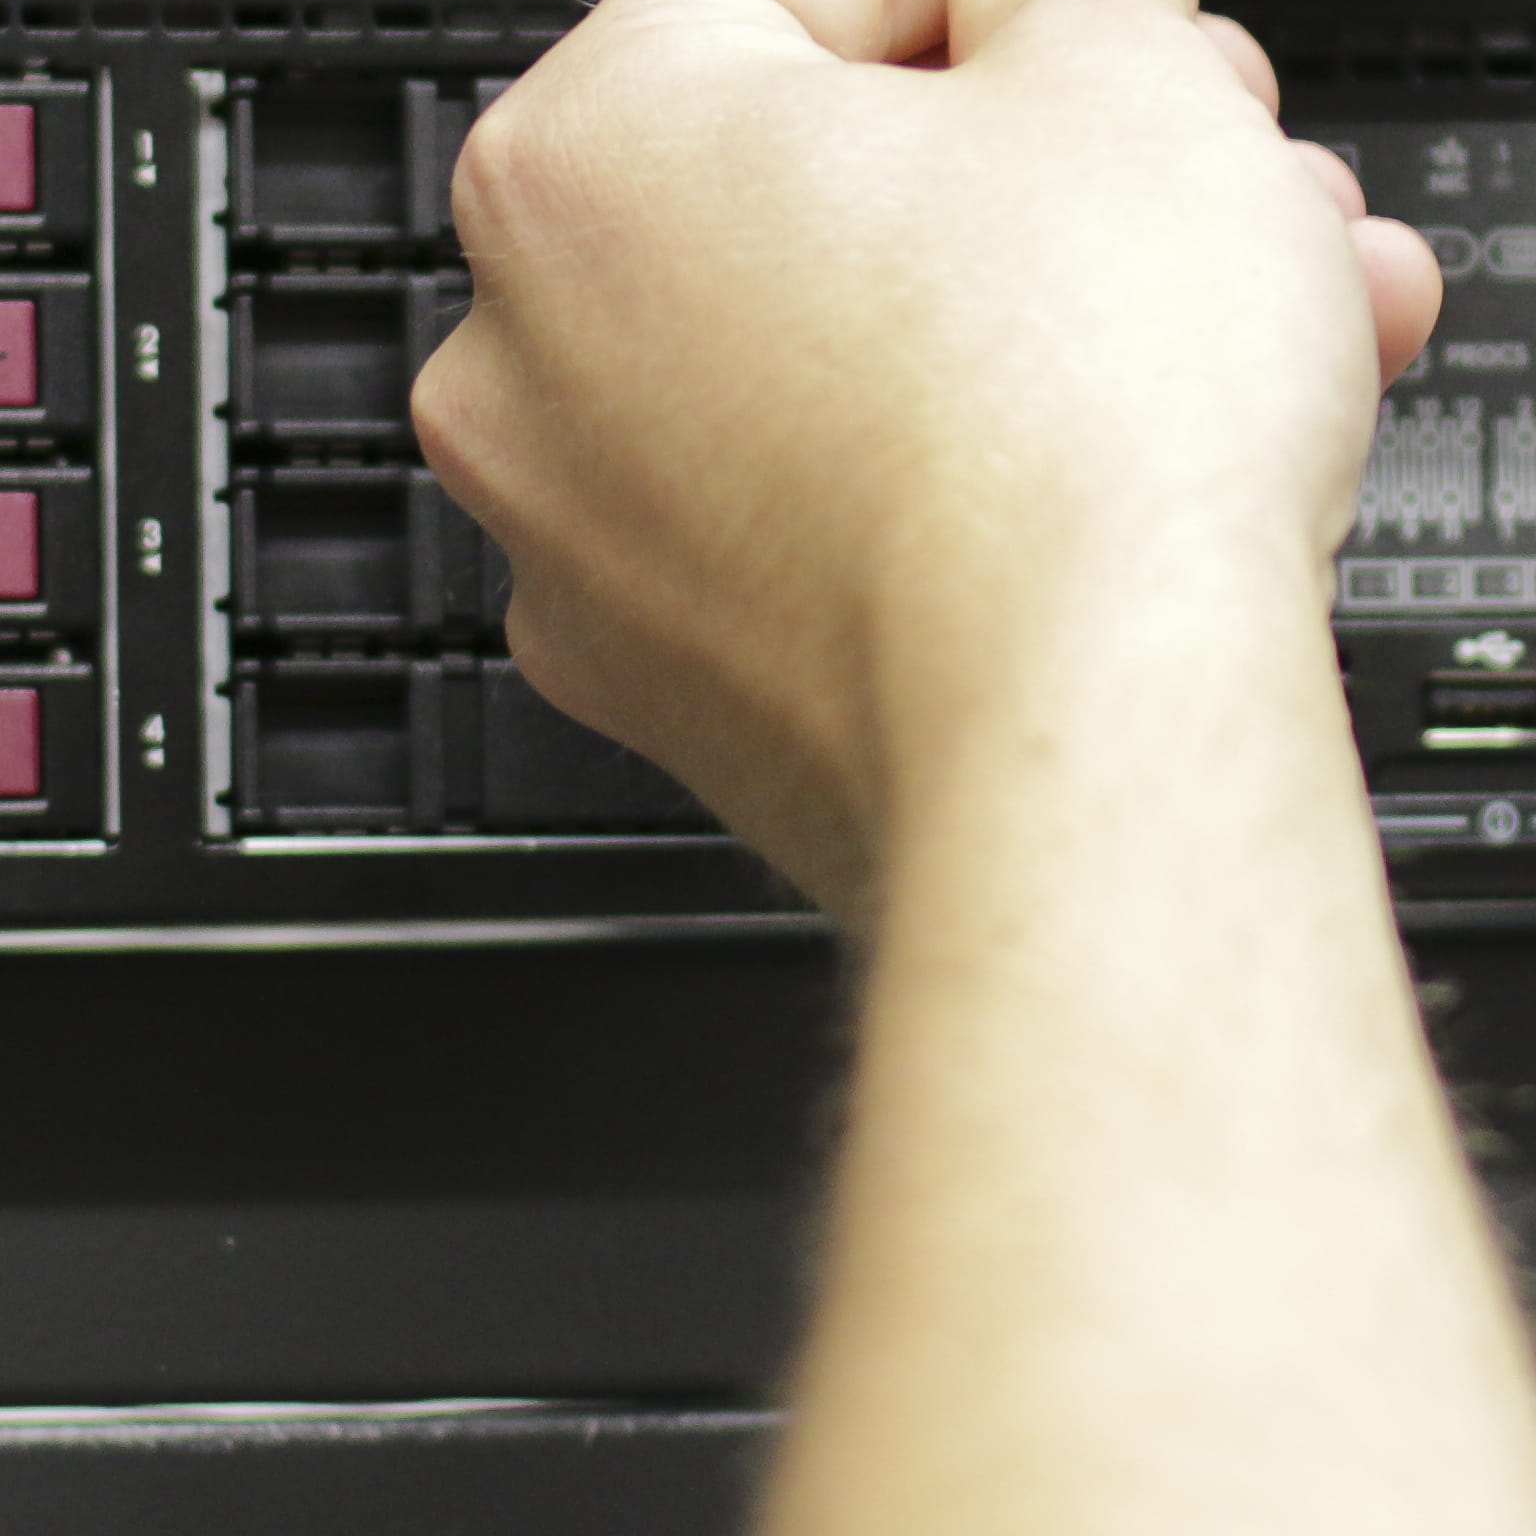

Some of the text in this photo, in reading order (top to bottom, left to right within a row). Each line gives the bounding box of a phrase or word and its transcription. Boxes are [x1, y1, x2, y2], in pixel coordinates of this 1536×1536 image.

[141, 130, 152, 161] 1
[139, 326, 159, 354] 2
[142, 519, 161, 549] 3
[141, 714, 164, 744] 4
